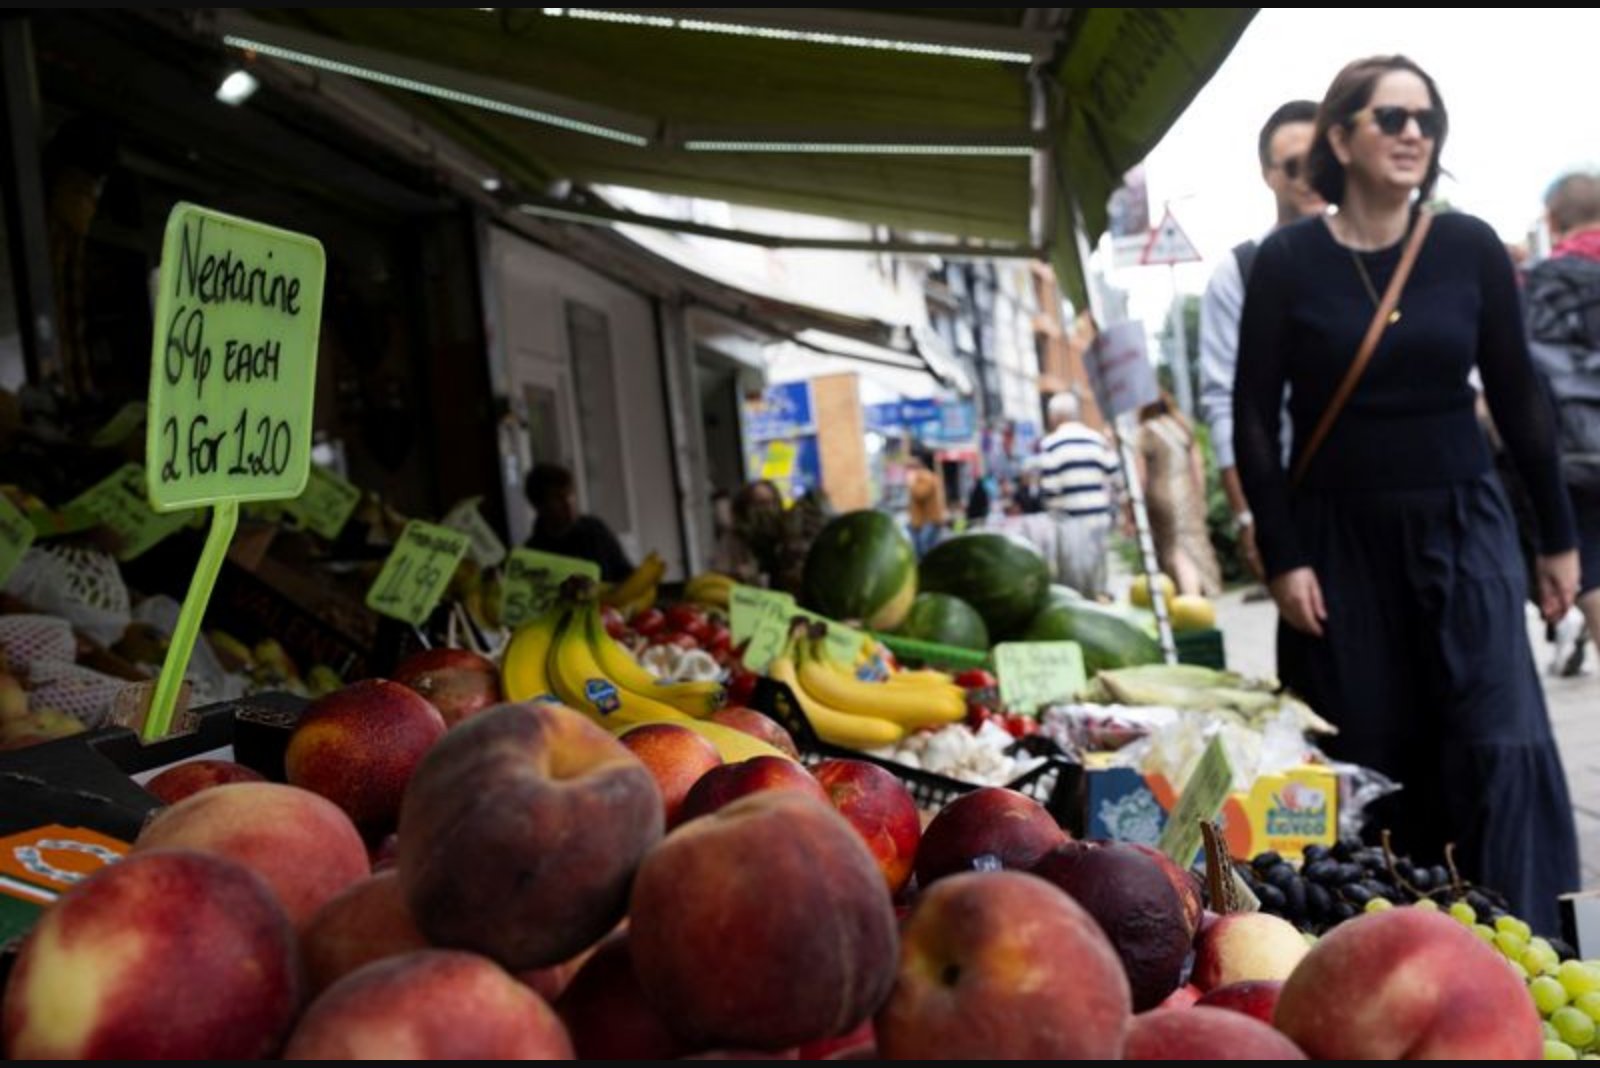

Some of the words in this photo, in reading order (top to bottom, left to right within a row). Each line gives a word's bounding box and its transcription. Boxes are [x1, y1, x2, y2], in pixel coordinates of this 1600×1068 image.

[175, 216, 301, 316] Nectarine
[165, 305, 212, 400] 69p
[223, 339, 282, 383] EACH
[161, 415, 182, 483] 2
[227, 407, 292, 478] 1.20
